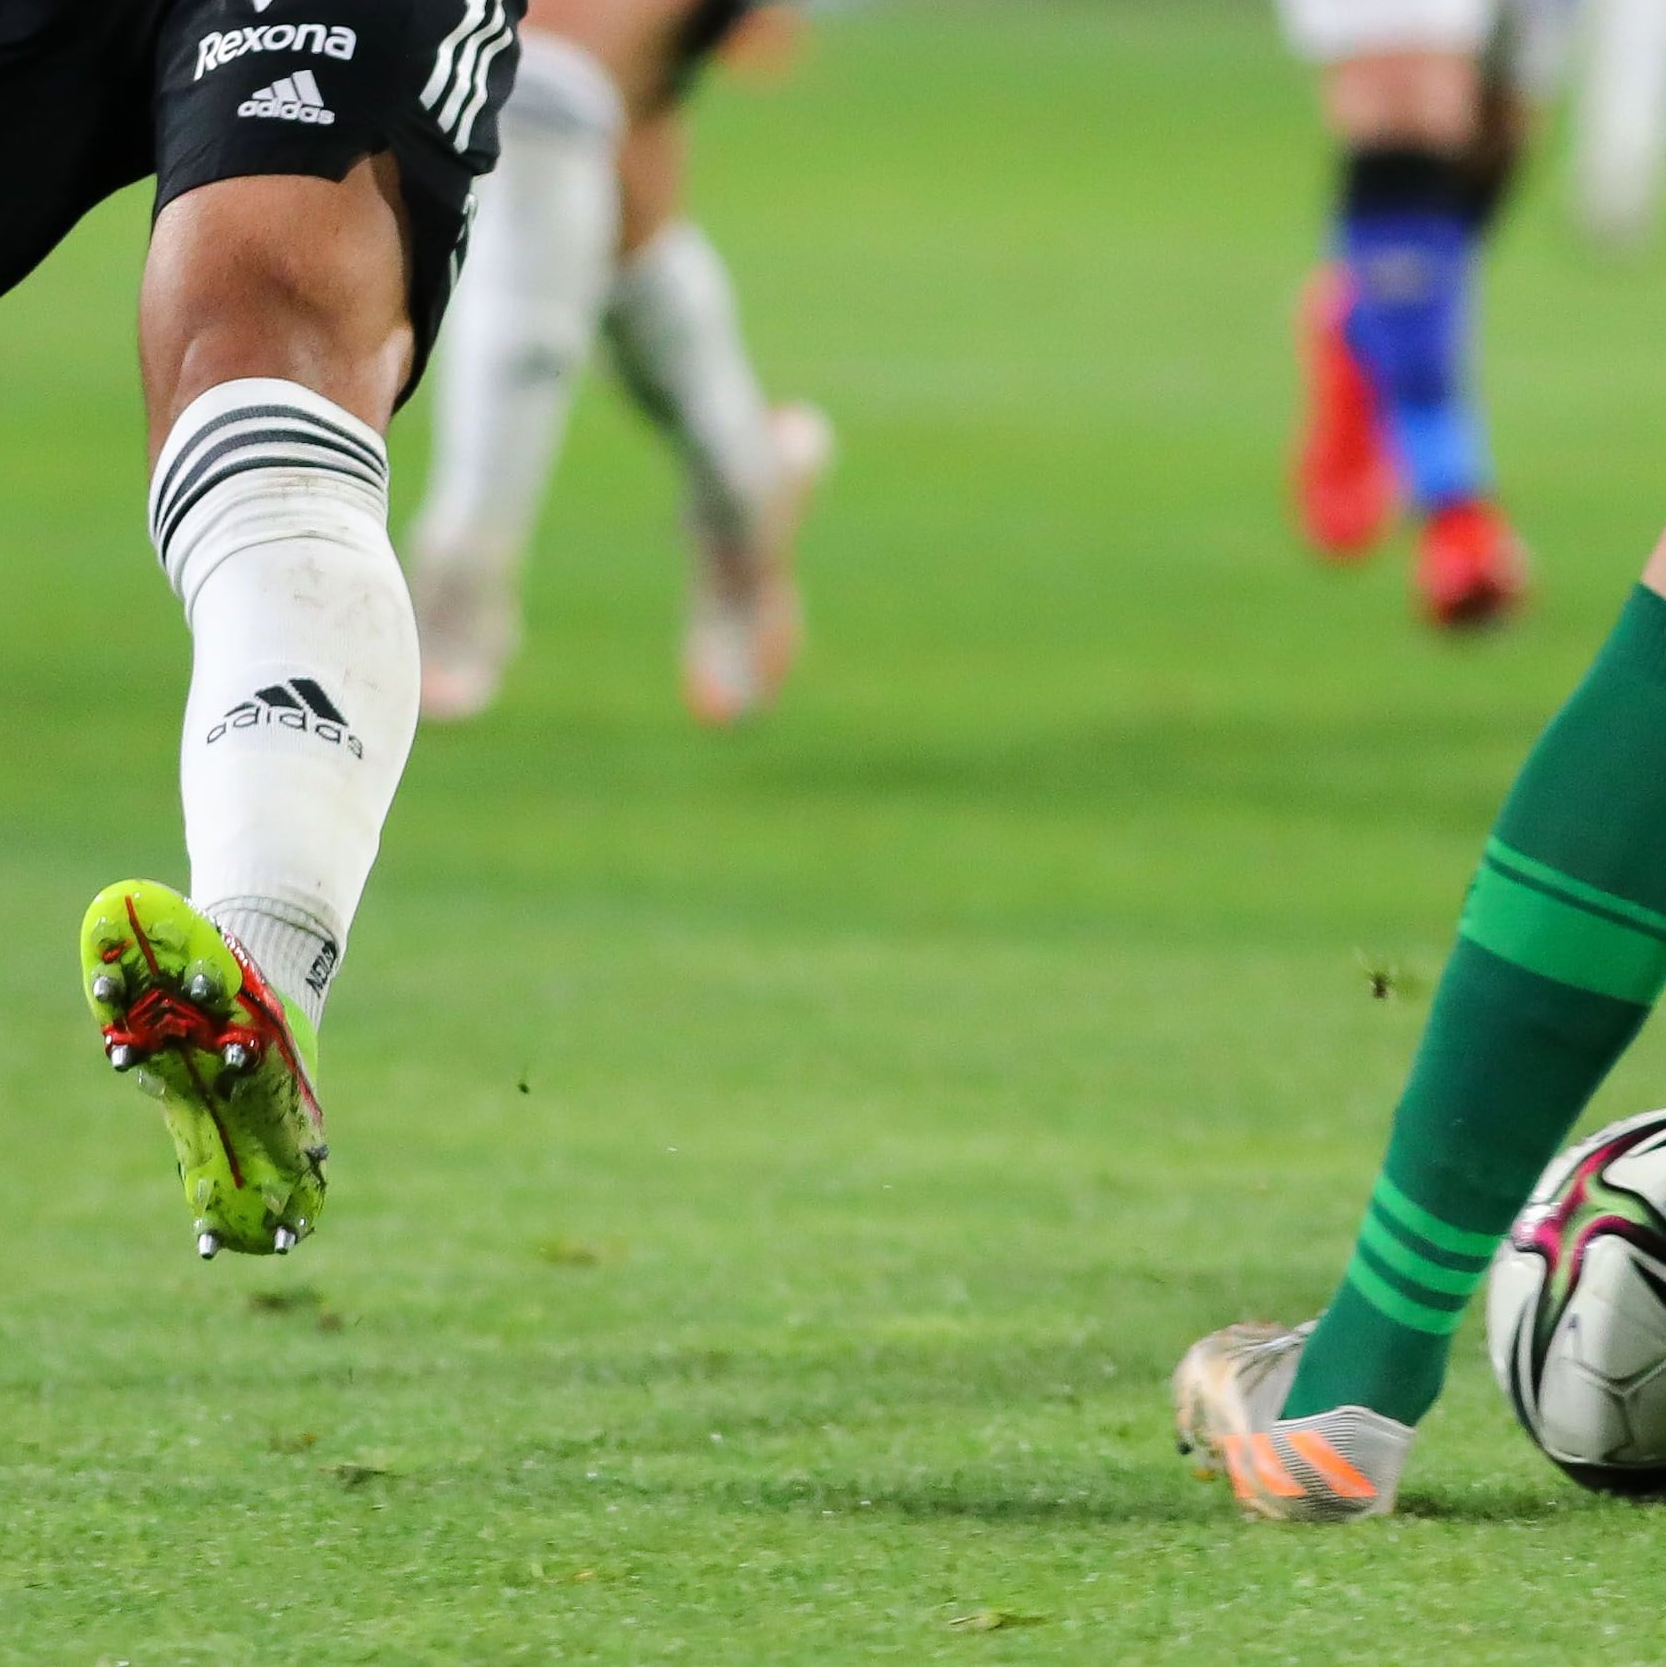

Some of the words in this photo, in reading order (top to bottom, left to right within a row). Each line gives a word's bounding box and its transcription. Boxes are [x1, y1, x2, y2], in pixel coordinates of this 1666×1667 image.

[193, 23, 357, 82] Rexona
[237, 97, 336, 125] adidas
[206, 705, 364, 760] adidas
